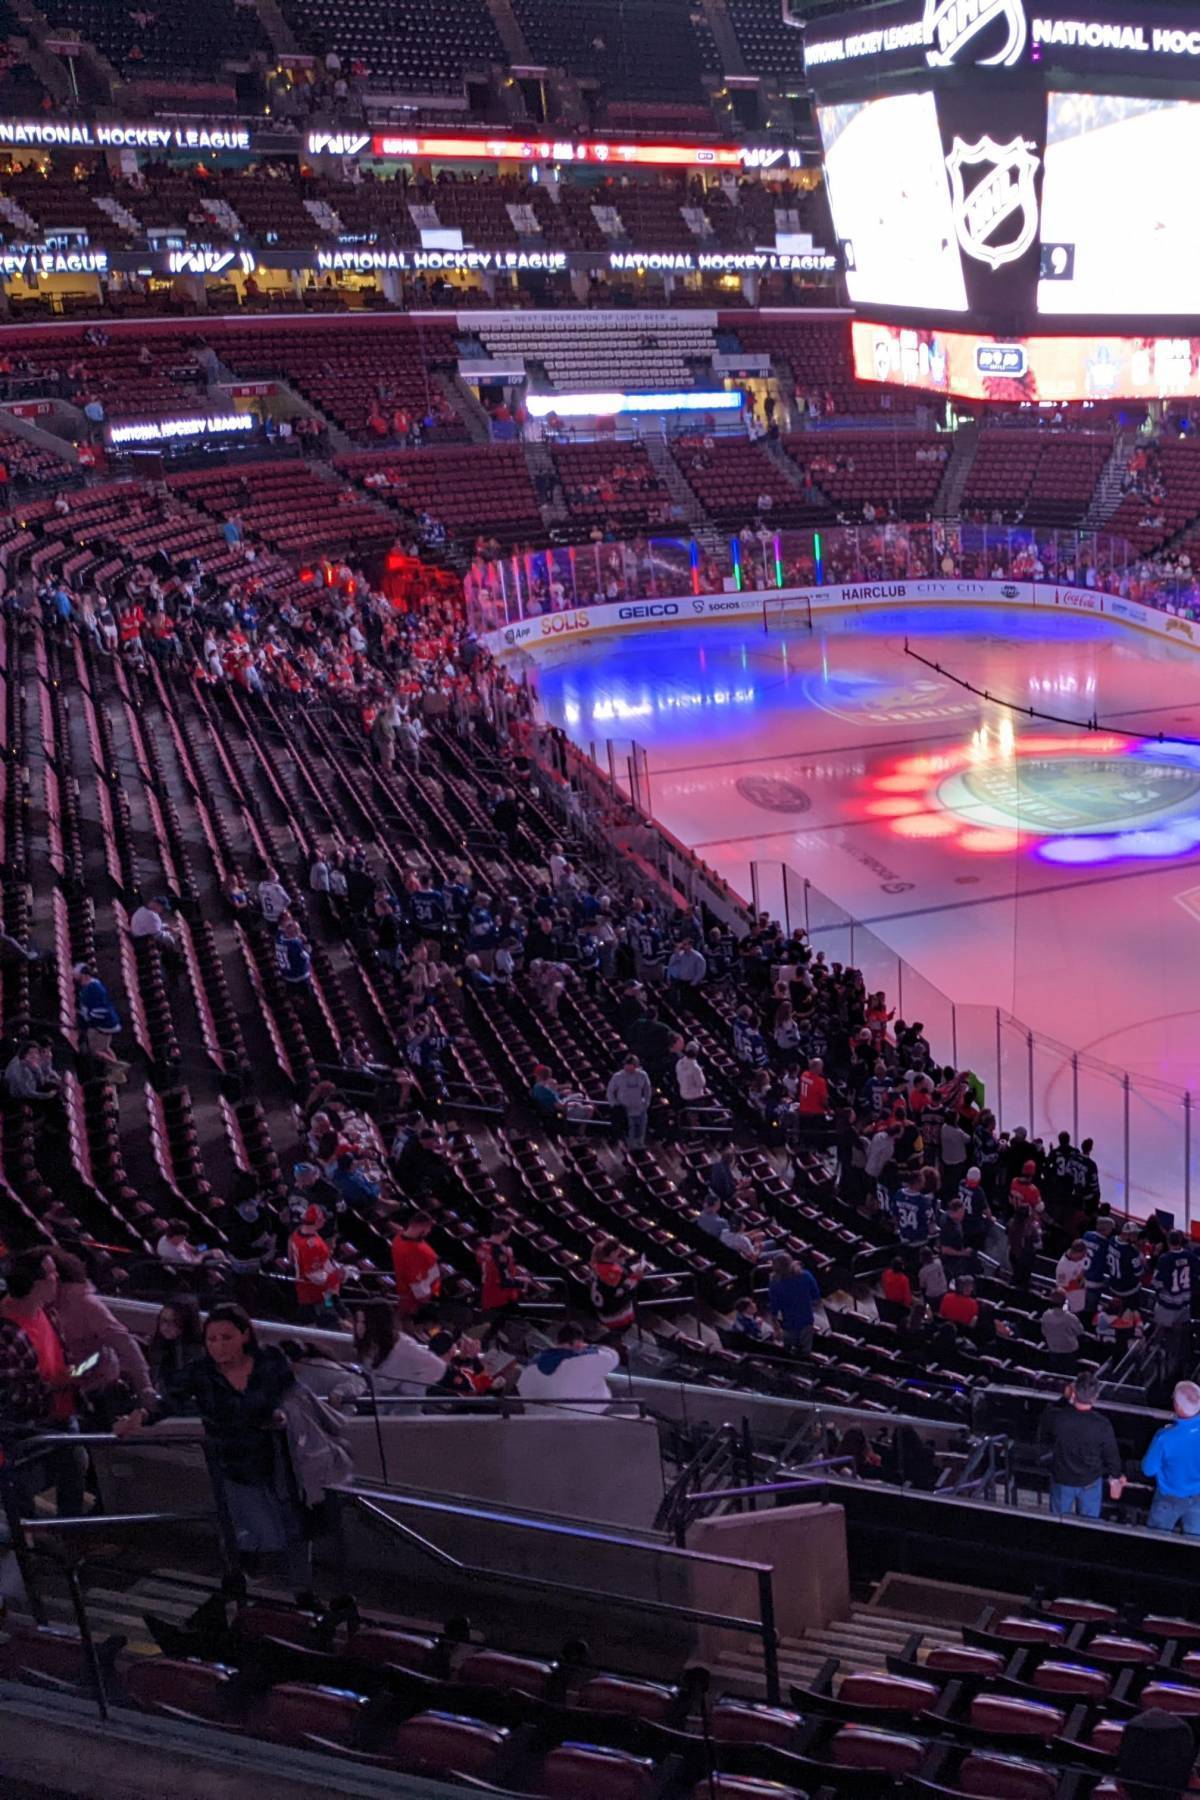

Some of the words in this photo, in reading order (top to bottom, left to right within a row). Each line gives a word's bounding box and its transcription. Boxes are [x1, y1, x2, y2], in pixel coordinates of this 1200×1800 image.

[846, 31, 882, 57] HOCKEY
[884, 22, 925, 52] LEAGUE
[1033, 19, 1148, 51] NATIONAL
[0, 124, 95, 146] NATIONAL
[98, 127, 172, 149] HOCKEY
[176, 131, 250, 150] LEAGUE
[969, 168, 1019, 235] NHL
[31, 254, 107, 273] LEAGUE
[318, 252, 410, 271] NATIONAL
[414, 253, 491, 271] HOCKEY
[495, 253, 566, 271] LEAGUE
[610, 254, 695, 271] NATIONAL
[699, 254, 767, 271] HOCKEY
[771, 255, 837, 272] LEAGUE
[842, 585, 906, 601] HAIRCLUB
[618, 603, 679, 620] GEICO
[541, 611, 590, 636] SOLIS
[898, 1208, 918, 1230] 34
[1170, 1265, 1191, 1293] 14
